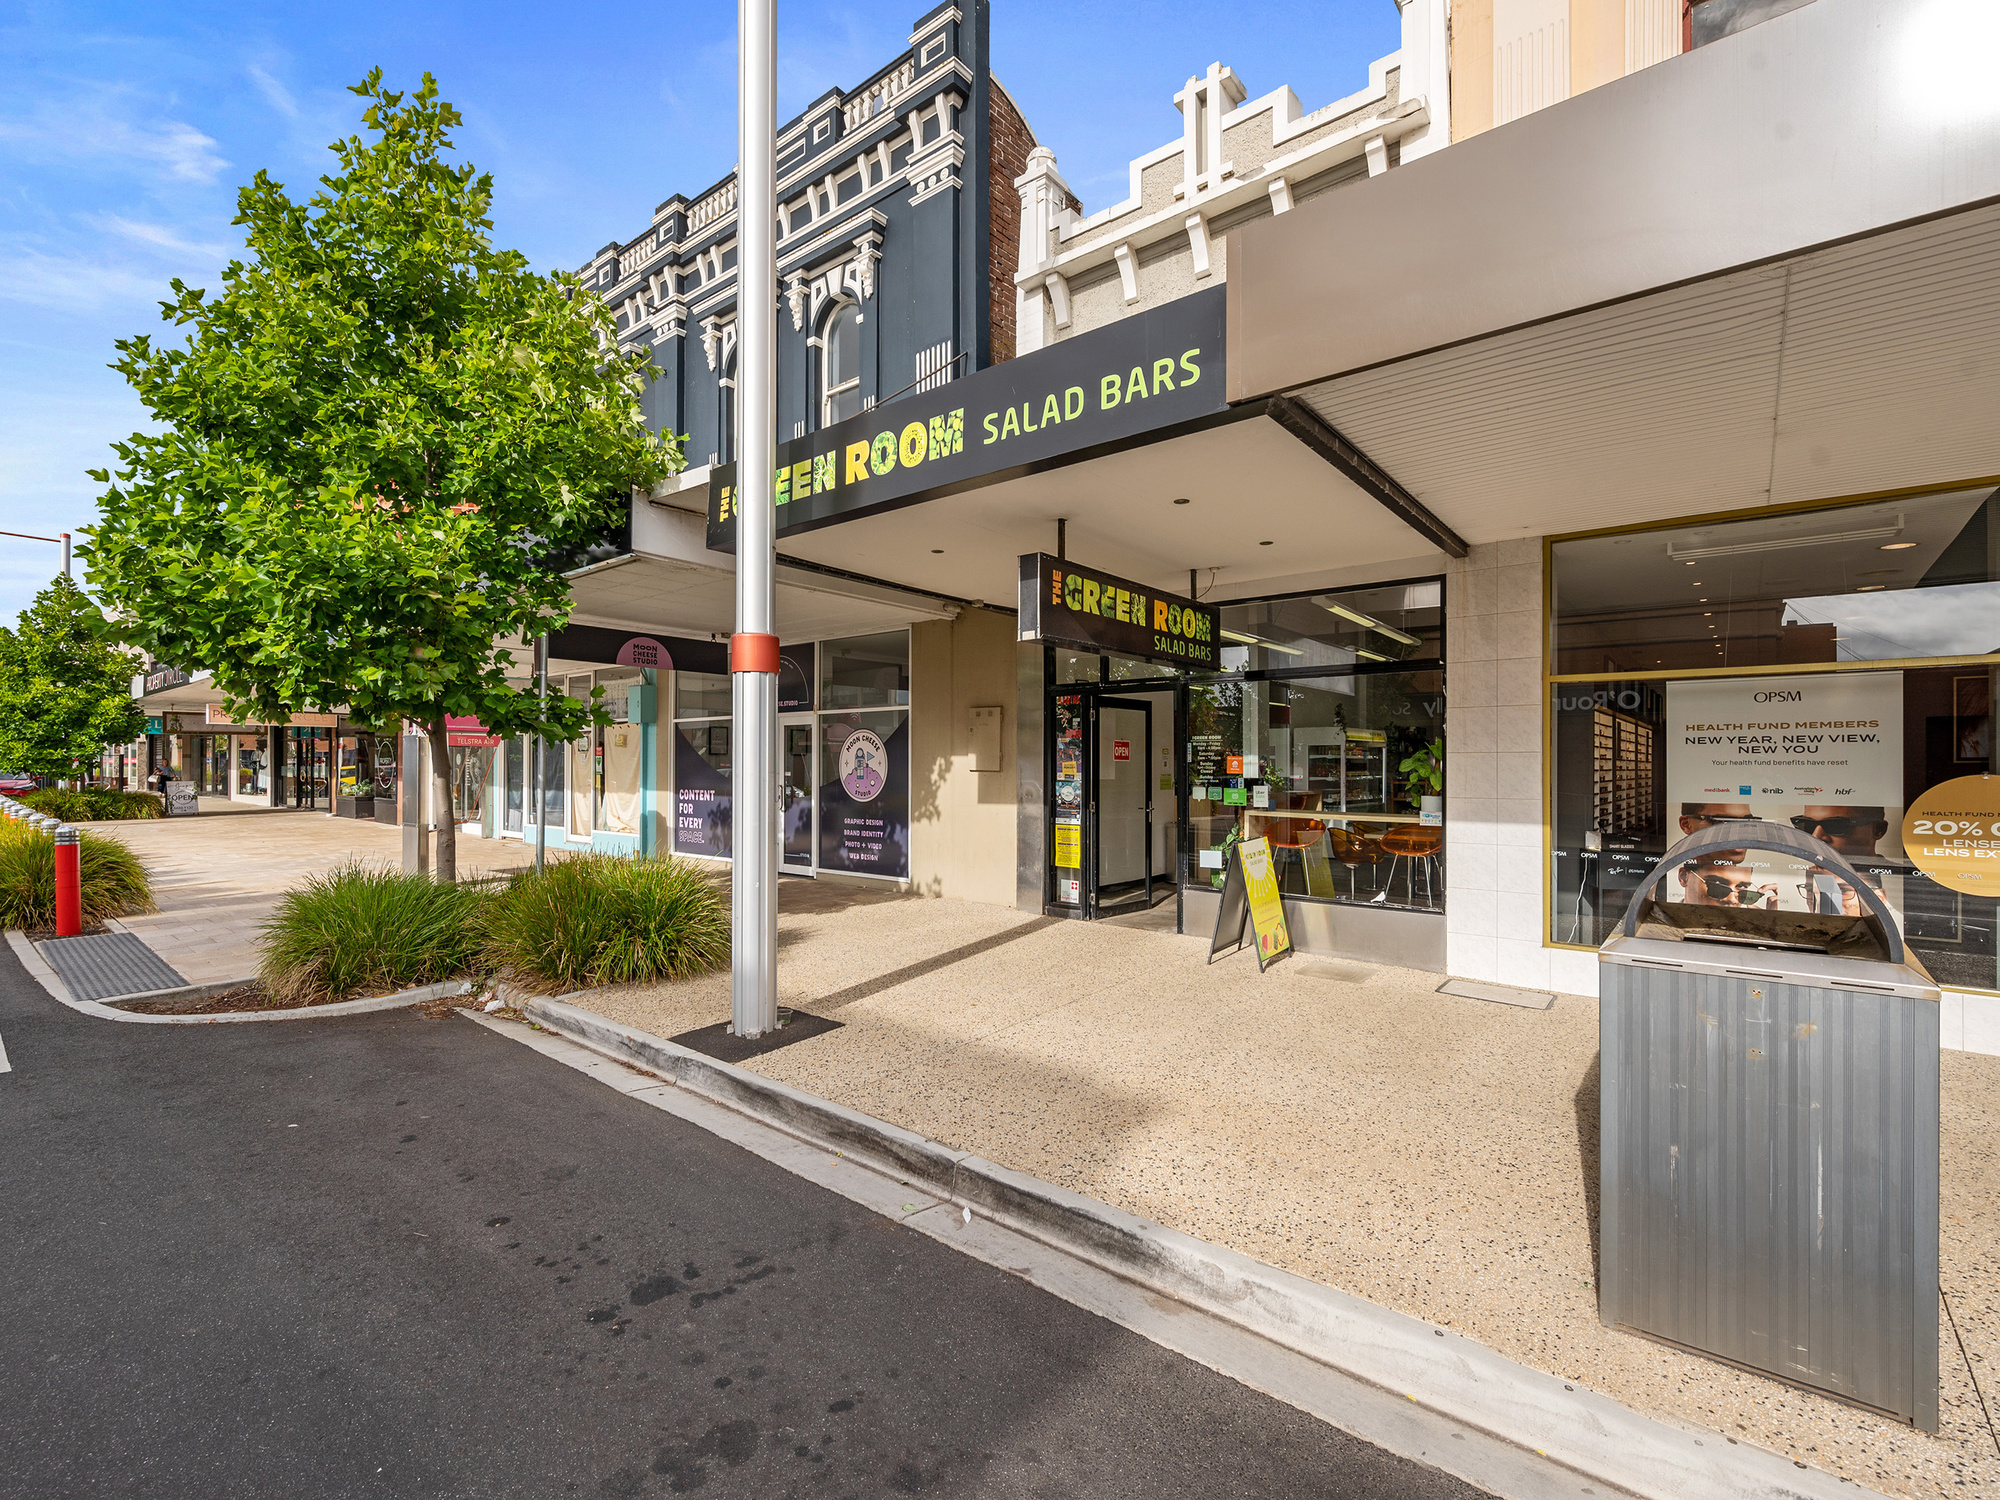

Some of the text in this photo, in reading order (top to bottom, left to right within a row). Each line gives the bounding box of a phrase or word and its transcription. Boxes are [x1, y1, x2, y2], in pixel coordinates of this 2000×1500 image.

[983, 348, 1201, 445] SALAD BARS
[719, 485, 731, 523] THE
[844, 408, 964, 486] ROOM
[1052, 569, 1211, 643] THE GREEN ROOM
[633, 643, 658, 653] MOON
[1154, 635, 1212, 662] SALAD BARS
[632, 650, 658, 659] CHEESE
[632, 657, 658, 666] STUDIO
[1754, 690, 1802, 703] OPSM
[1685, 720, 1880, 731] HEALTH FUND MEMBERS
[846, 735, 881, 752] MOON CHEESE
[1685, 734, 1880, 745] NEW YEAR, NEW VIEW,
[1115, 746, 1129, 757] OPEN
[1738, 745, 1819, 754] NEW YOU
[679, 788, 716, 802] CONTENT
[855, 789, 872, 797] STUDIO
[1769, 787, 1784, 795] nib
[1834, 787, 1853, 795] hbf
[678, 803, 694, 815] FOR
[678, 817, 704, 830] EVERY
[844, 817, 884, 826] GRAPHIC DESIGN
[843, 829, 884, 838] BRAND IDENTITY
[1912, 819, 1983, 837] 20%
[678, 829, 705, 844] SPACE.
[849, 852, 860, 860] WEB
[1923, 847, 1970, 857] LENS
[1912, 870, 1936, 878] OPSM
